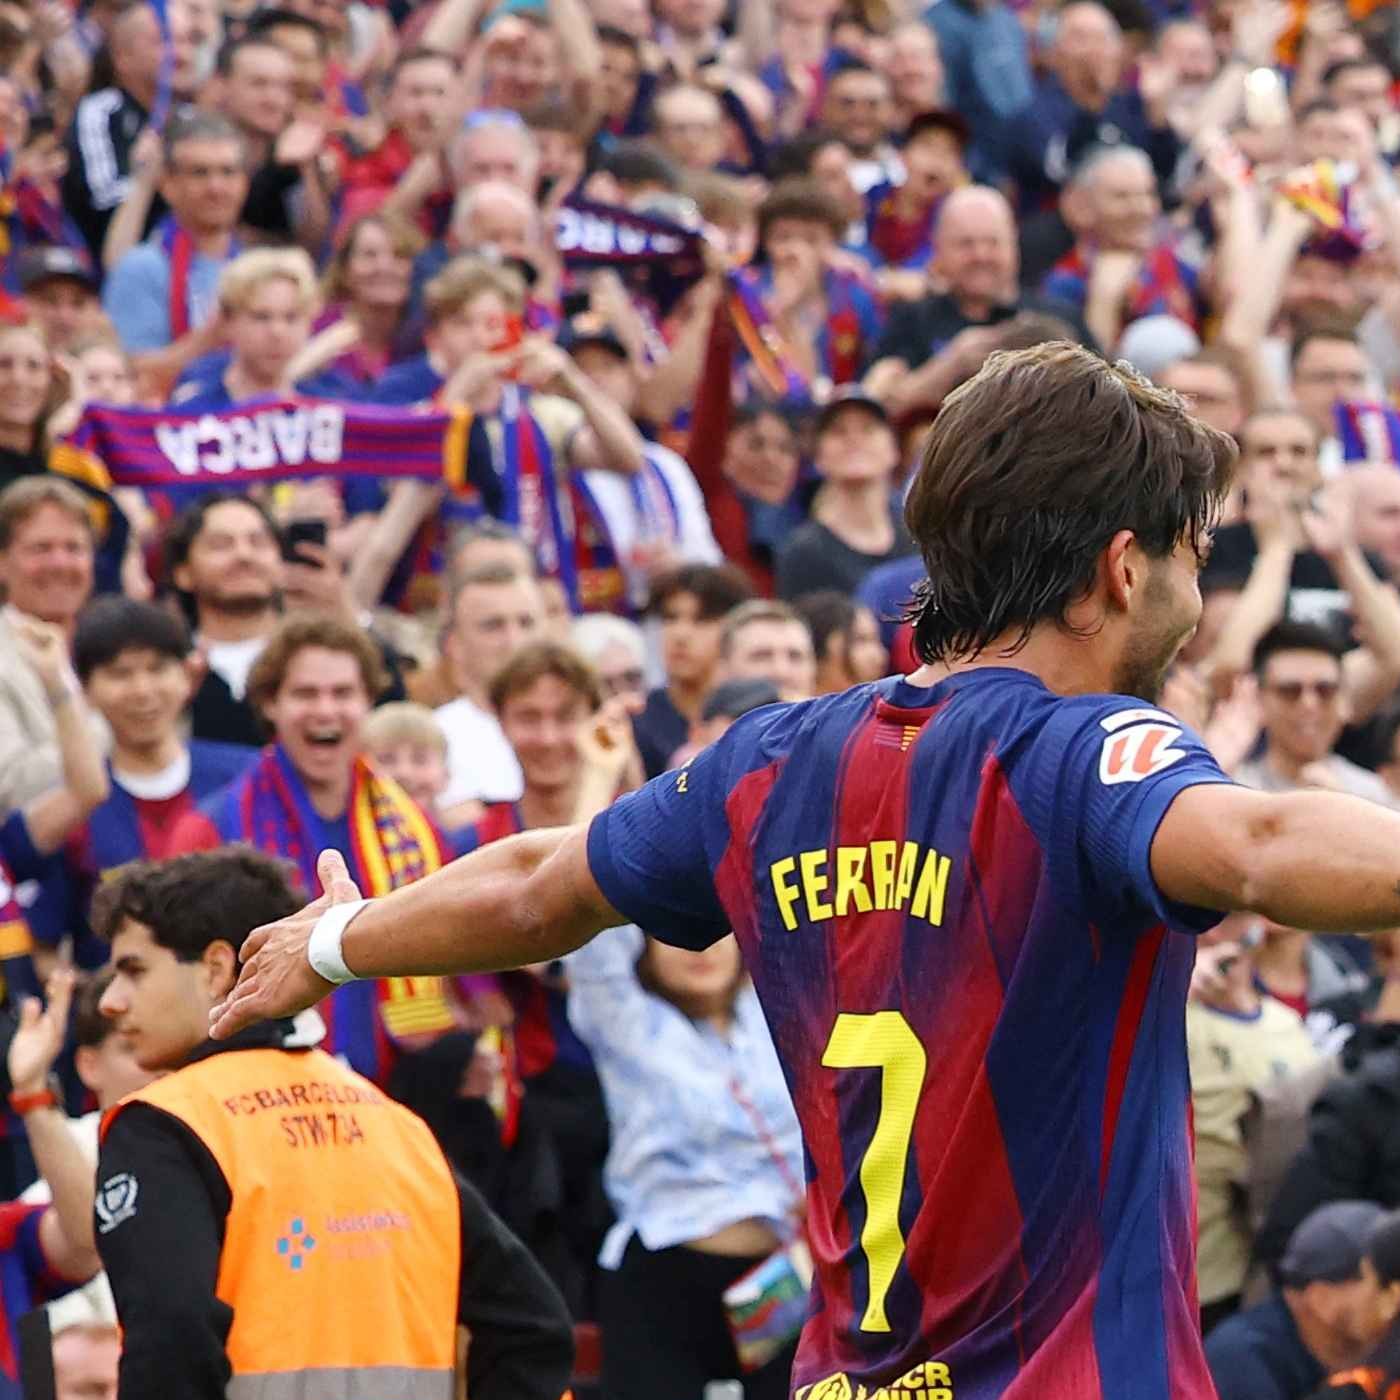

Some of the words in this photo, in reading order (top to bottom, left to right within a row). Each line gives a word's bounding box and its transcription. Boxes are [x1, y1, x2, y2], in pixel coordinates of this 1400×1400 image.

[154, 405, 345, 475] BARÇA
[770, 839, 952, 932] FERRAN
[820, 1010, 927, 1331] 7
